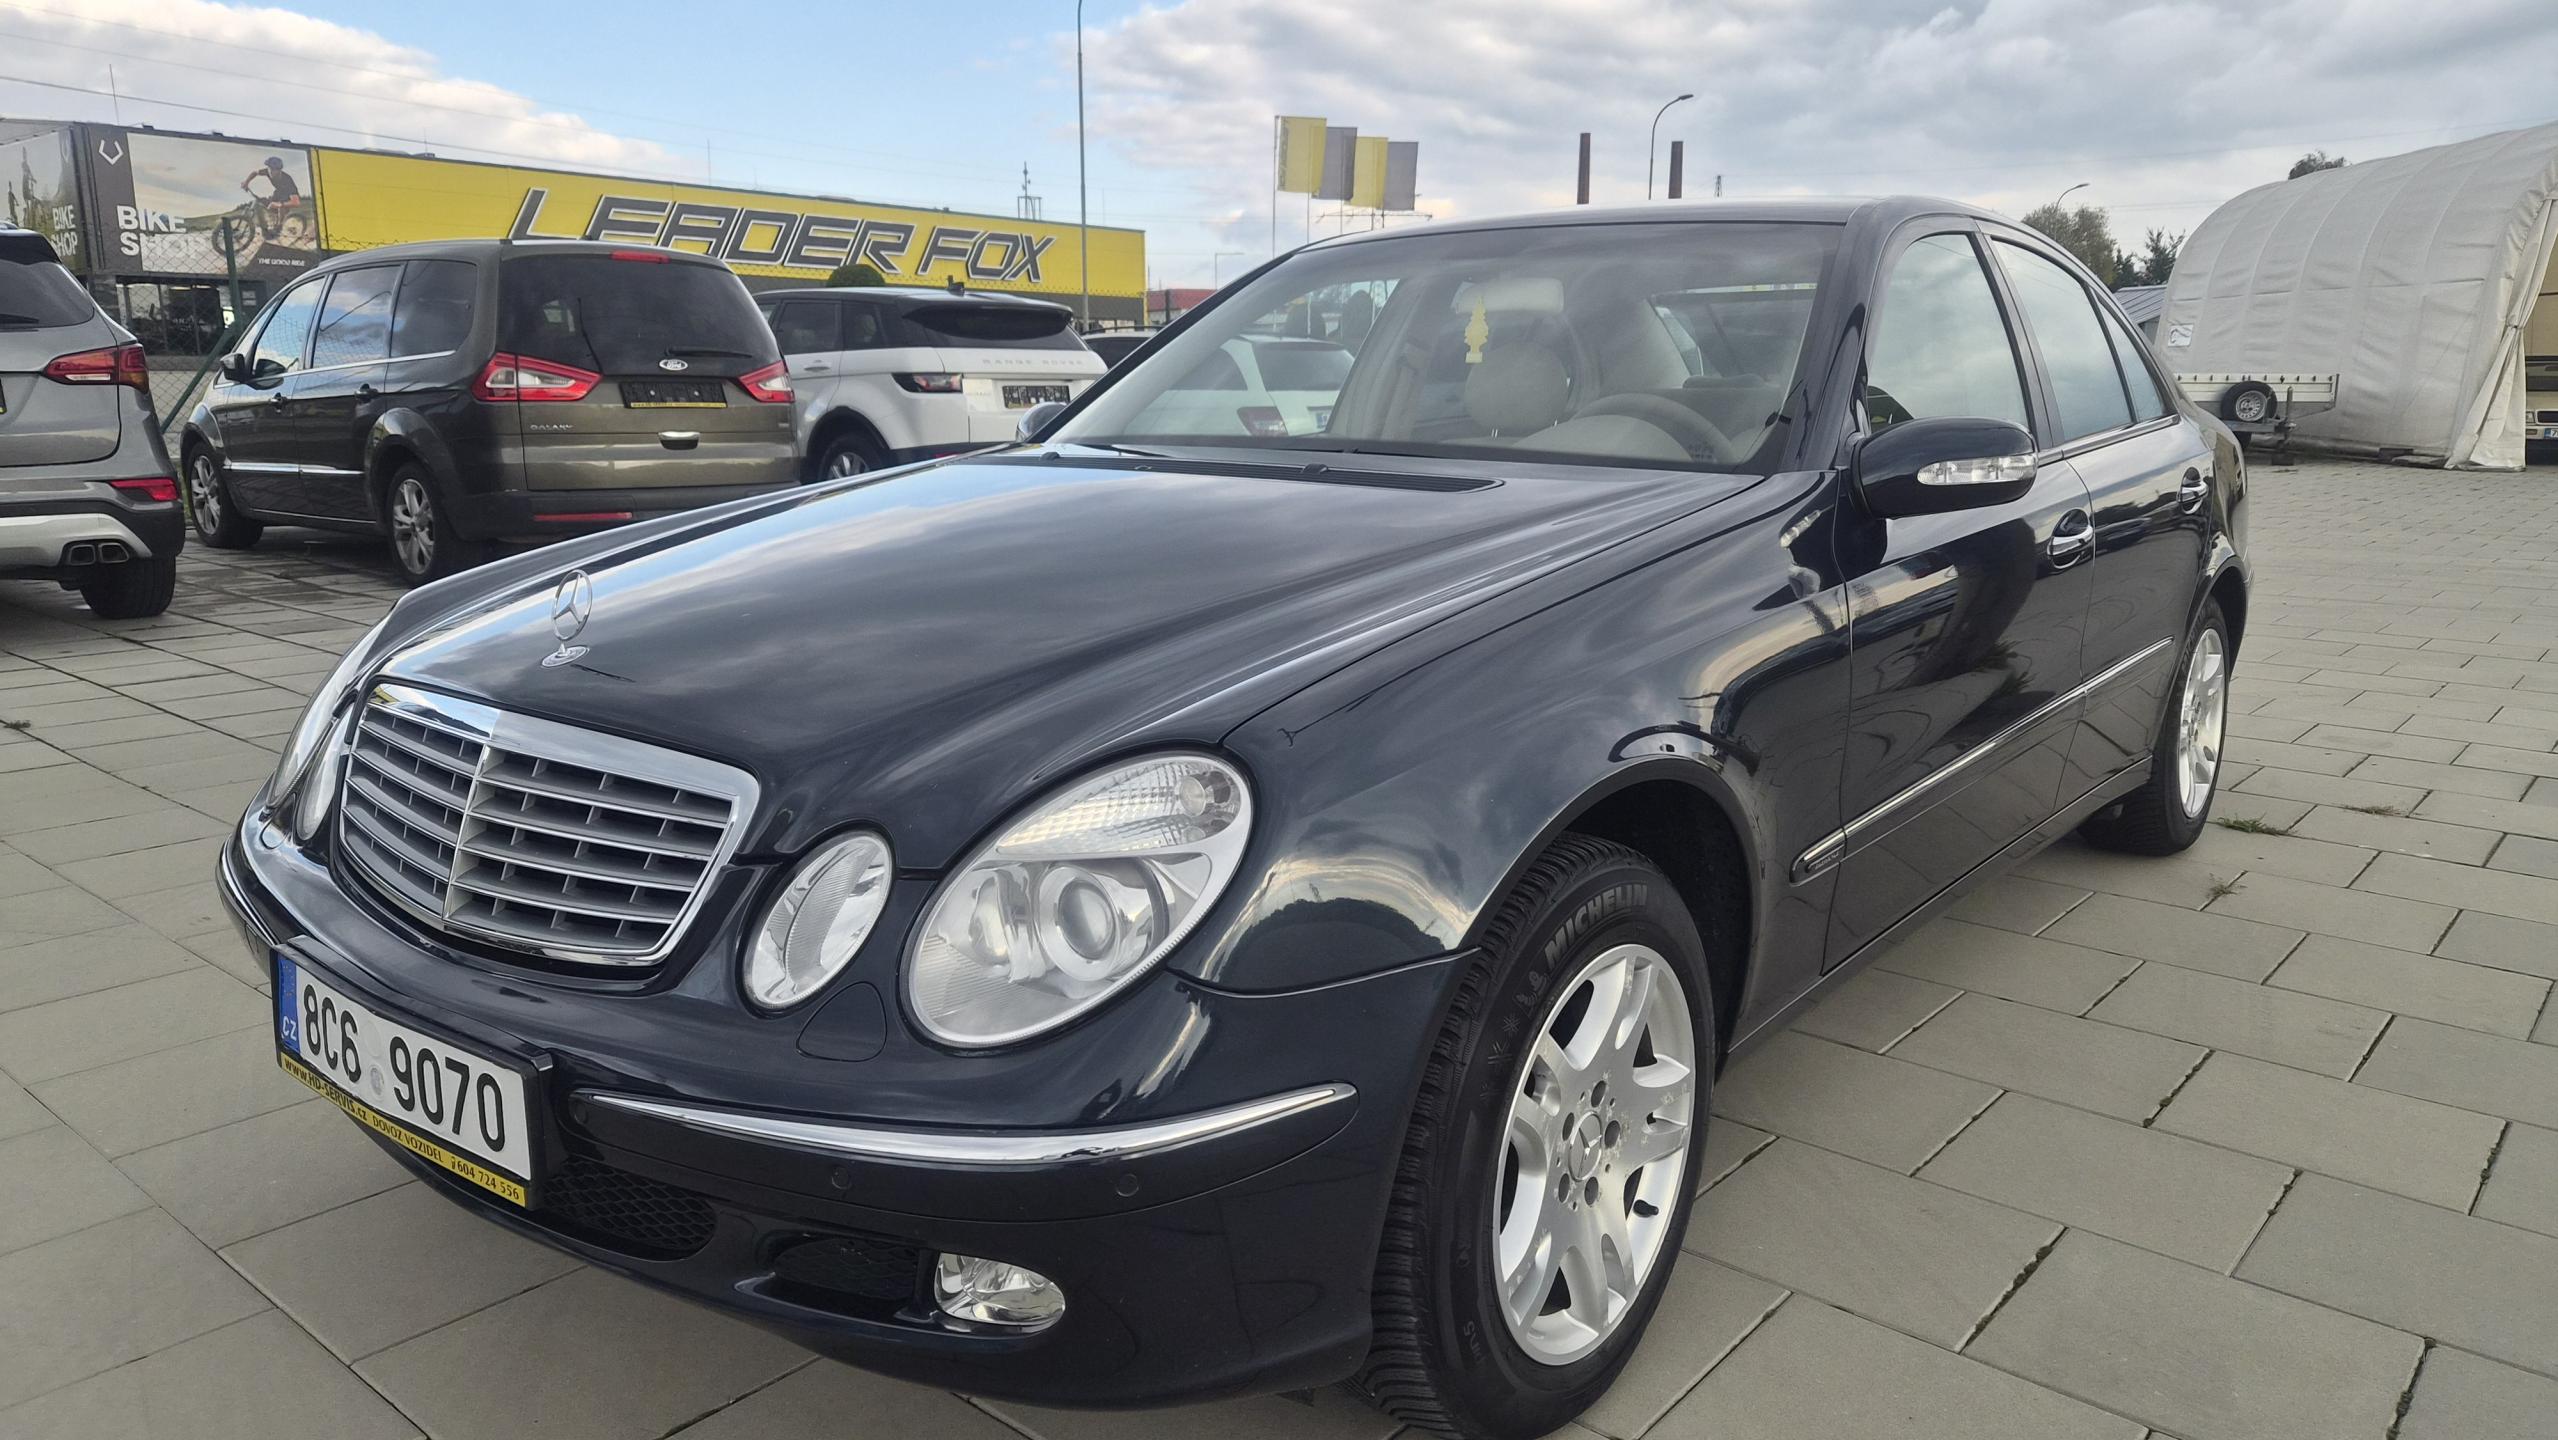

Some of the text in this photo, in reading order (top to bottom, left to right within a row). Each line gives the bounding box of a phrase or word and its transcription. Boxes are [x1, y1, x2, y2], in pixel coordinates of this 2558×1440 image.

[52, 204, 76, 231] BIKE
[117, 205, 187, 233] BIKE
[510, 187, 1057, 283] LEADER FOX
[1544, 884, 1648, 970] MICHELIN
[282, 1015, 297, 1041] CZ
[303, 984, 506, 1152] 8C6 9070
[372, 1115, 403, 1142] DOVOZ
[403, 1133, 444, 1162] VOZIDEL
[457, 1161, 475, 1178] 604
[478, 1171, 497, 1189] 724
[500, 1181, 519, 1200] 556
